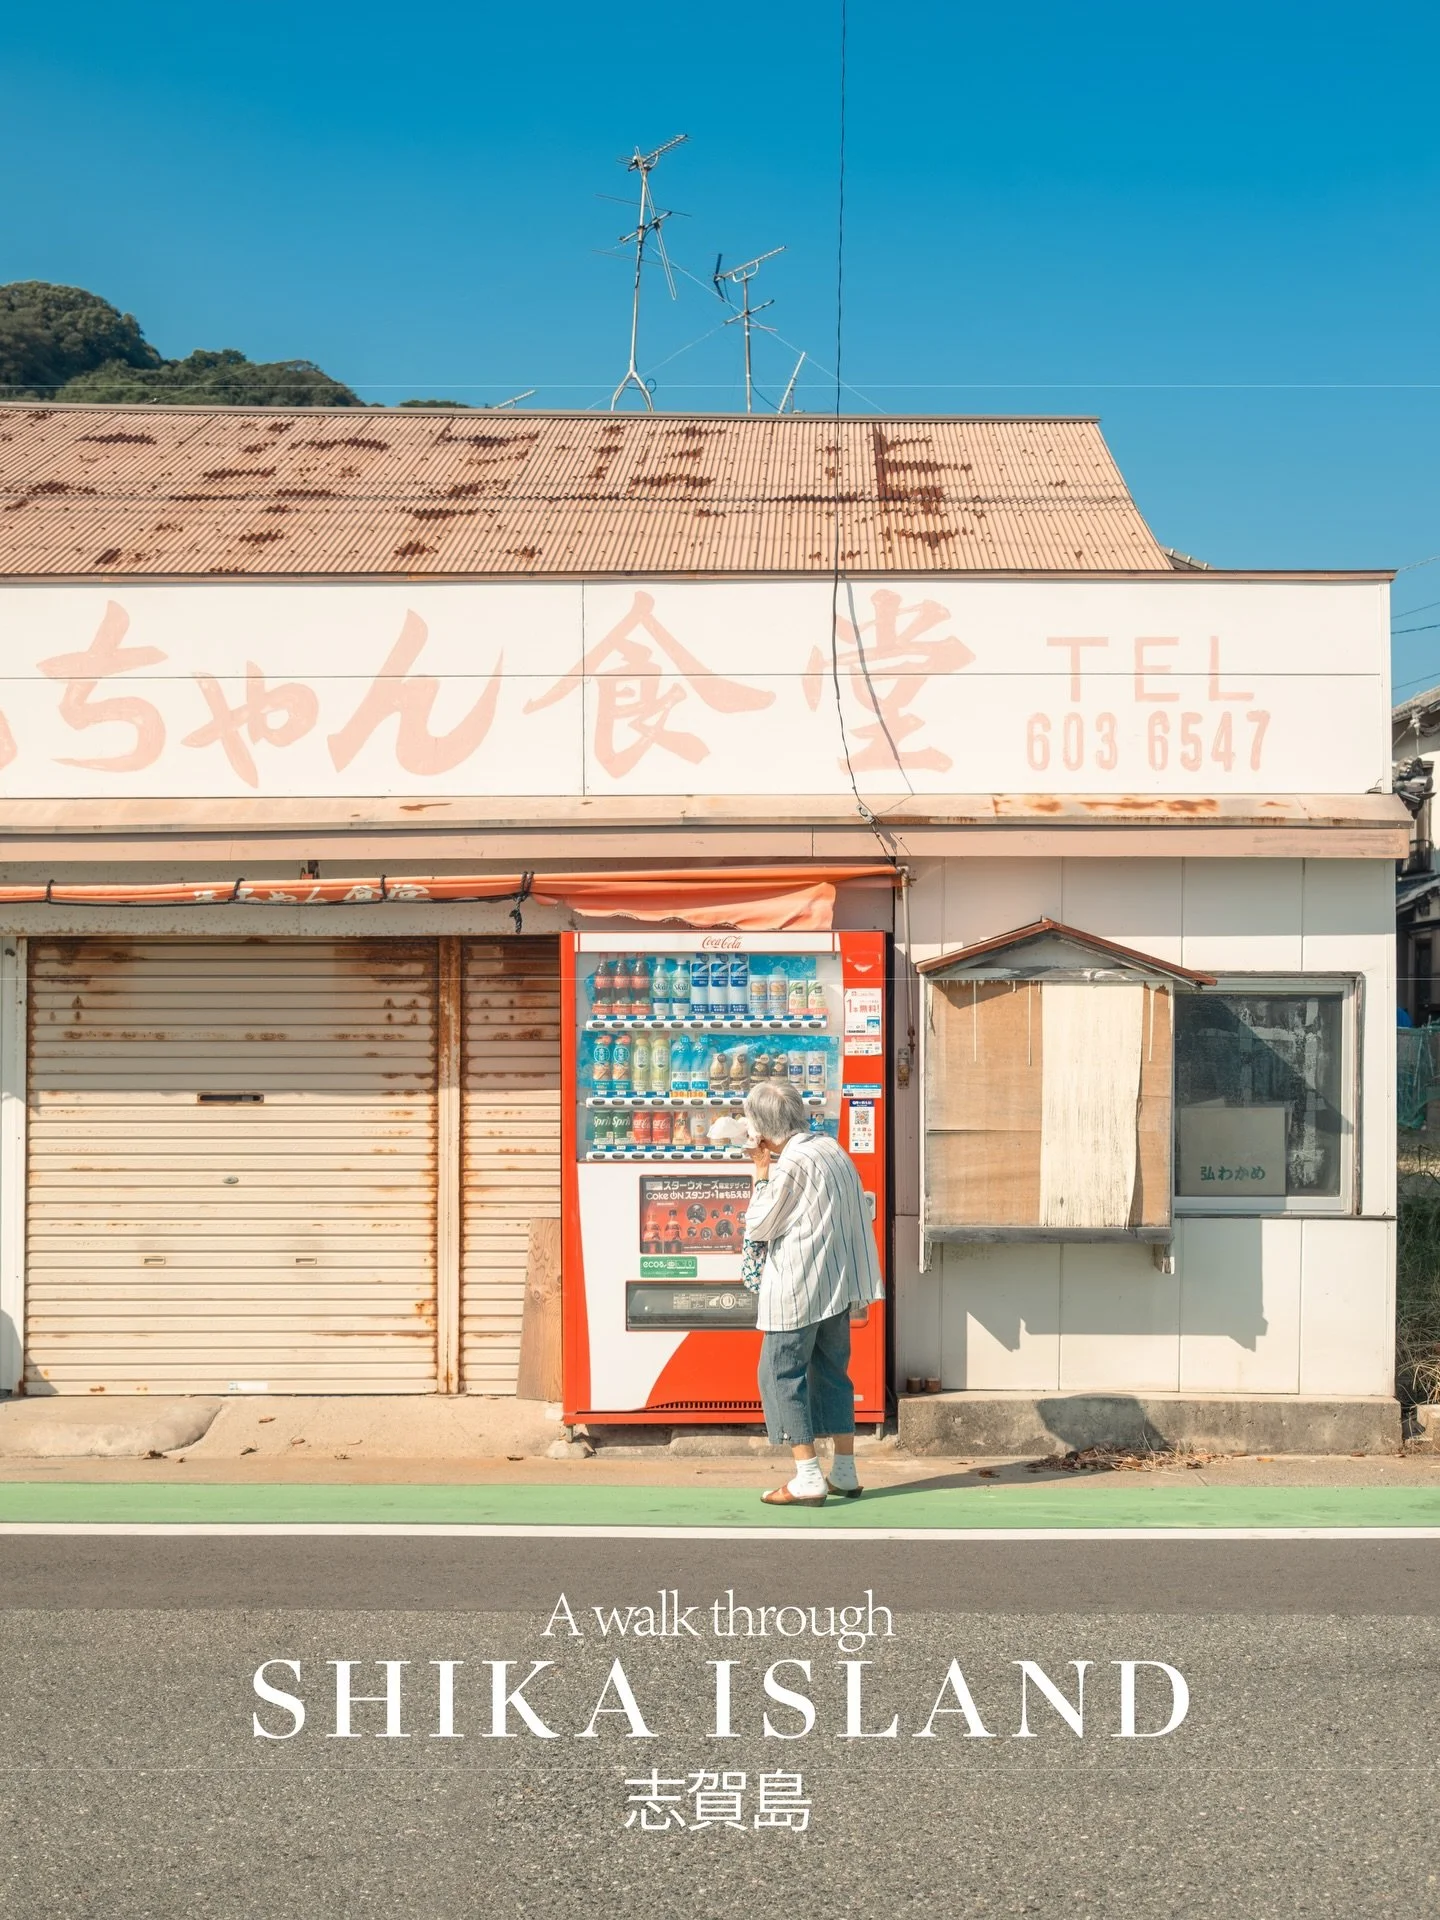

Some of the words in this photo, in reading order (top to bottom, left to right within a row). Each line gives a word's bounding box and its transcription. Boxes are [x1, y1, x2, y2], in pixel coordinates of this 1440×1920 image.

[0, 590, 975, 788] ちゃん食堂
[1047, 636, 1253, 702] TEL
[1027, 711, 1118, 771] 603
[1147, 709, 1271, 773] 6547
[701, 935, 742, 949] Coca-Cola
[646, 1191, 668, 1200] Coke
